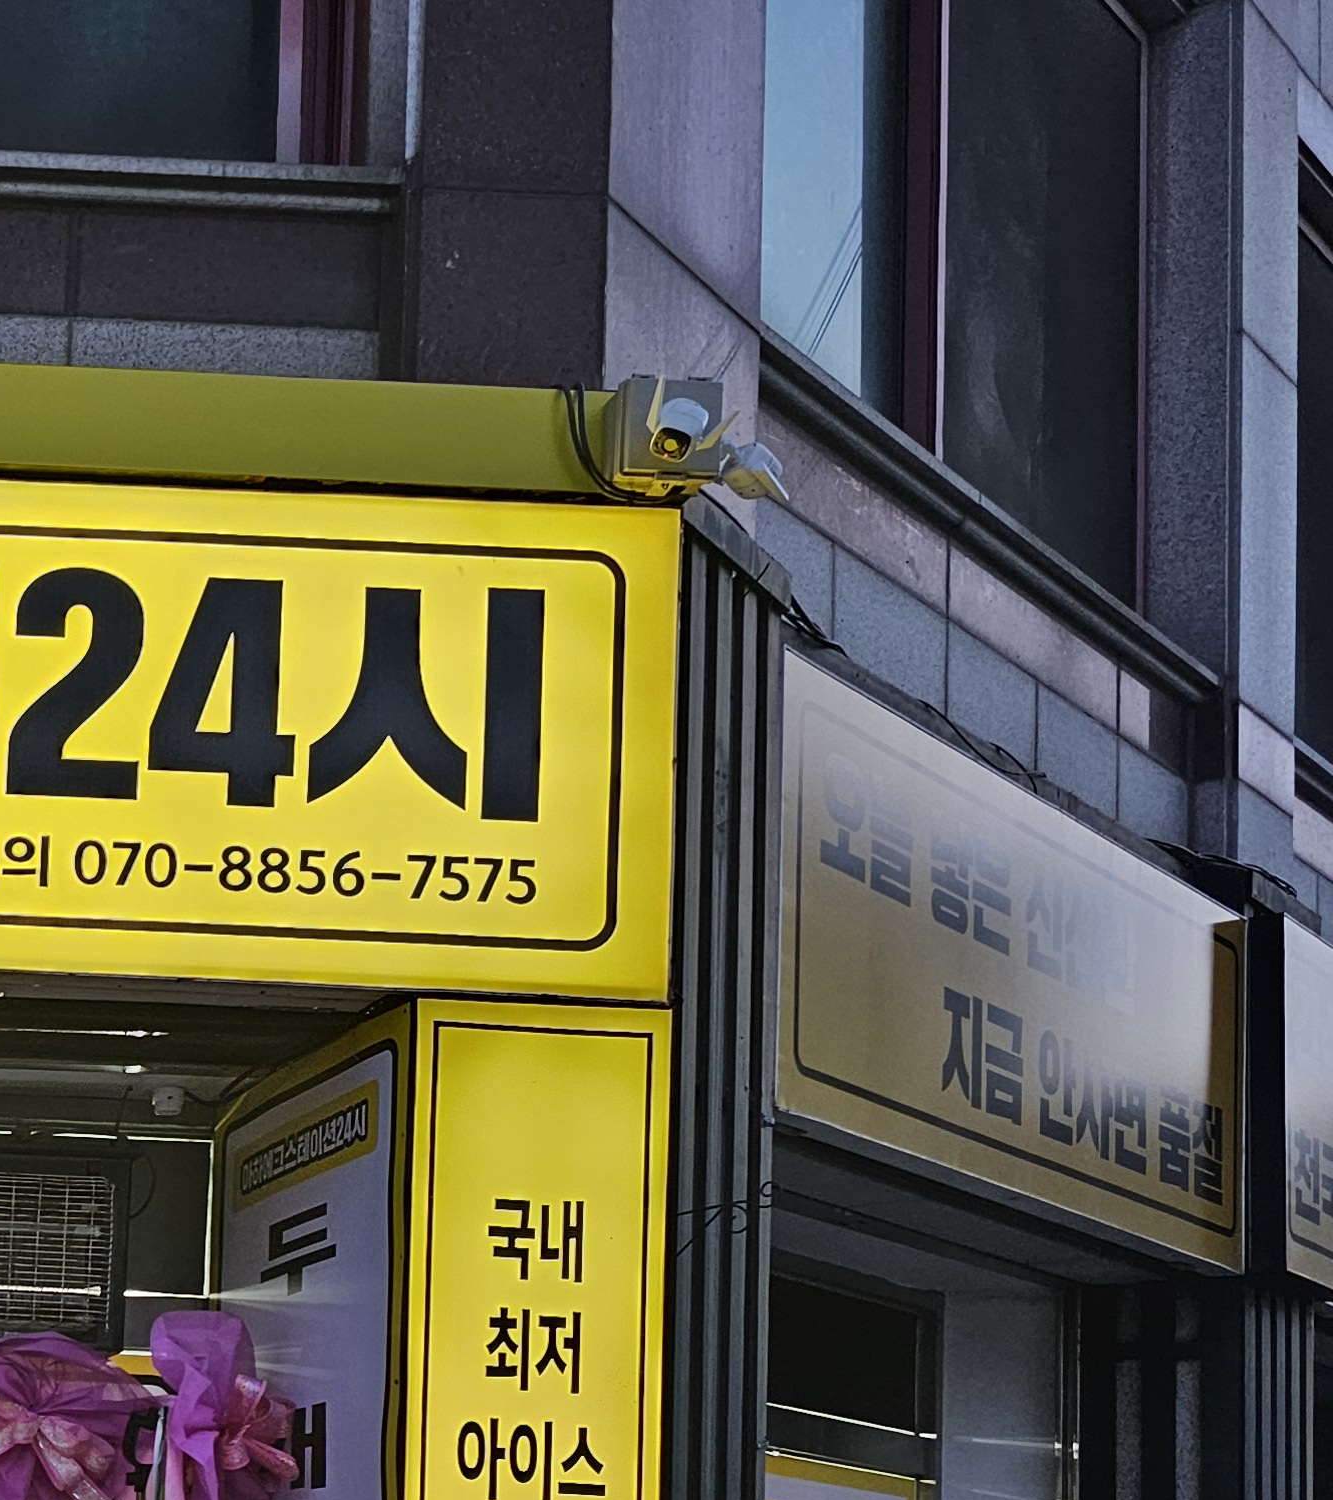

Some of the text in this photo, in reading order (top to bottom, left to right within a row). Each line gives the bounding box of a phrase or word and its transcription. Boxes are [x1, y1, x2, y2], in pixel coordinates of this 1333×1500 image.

[74, 837, 538, 907] 070-8856-7575
[818, 752, 915, 907] 오늘
[941, 985, 1025, 1126] 지금
[1038, 1029, 1148, 1176] 안사면
[259, 1202, 337, 1297] 두
[487, 1197, 586, 1284] 국내
[485, 1306, 583, 1395] 최저
